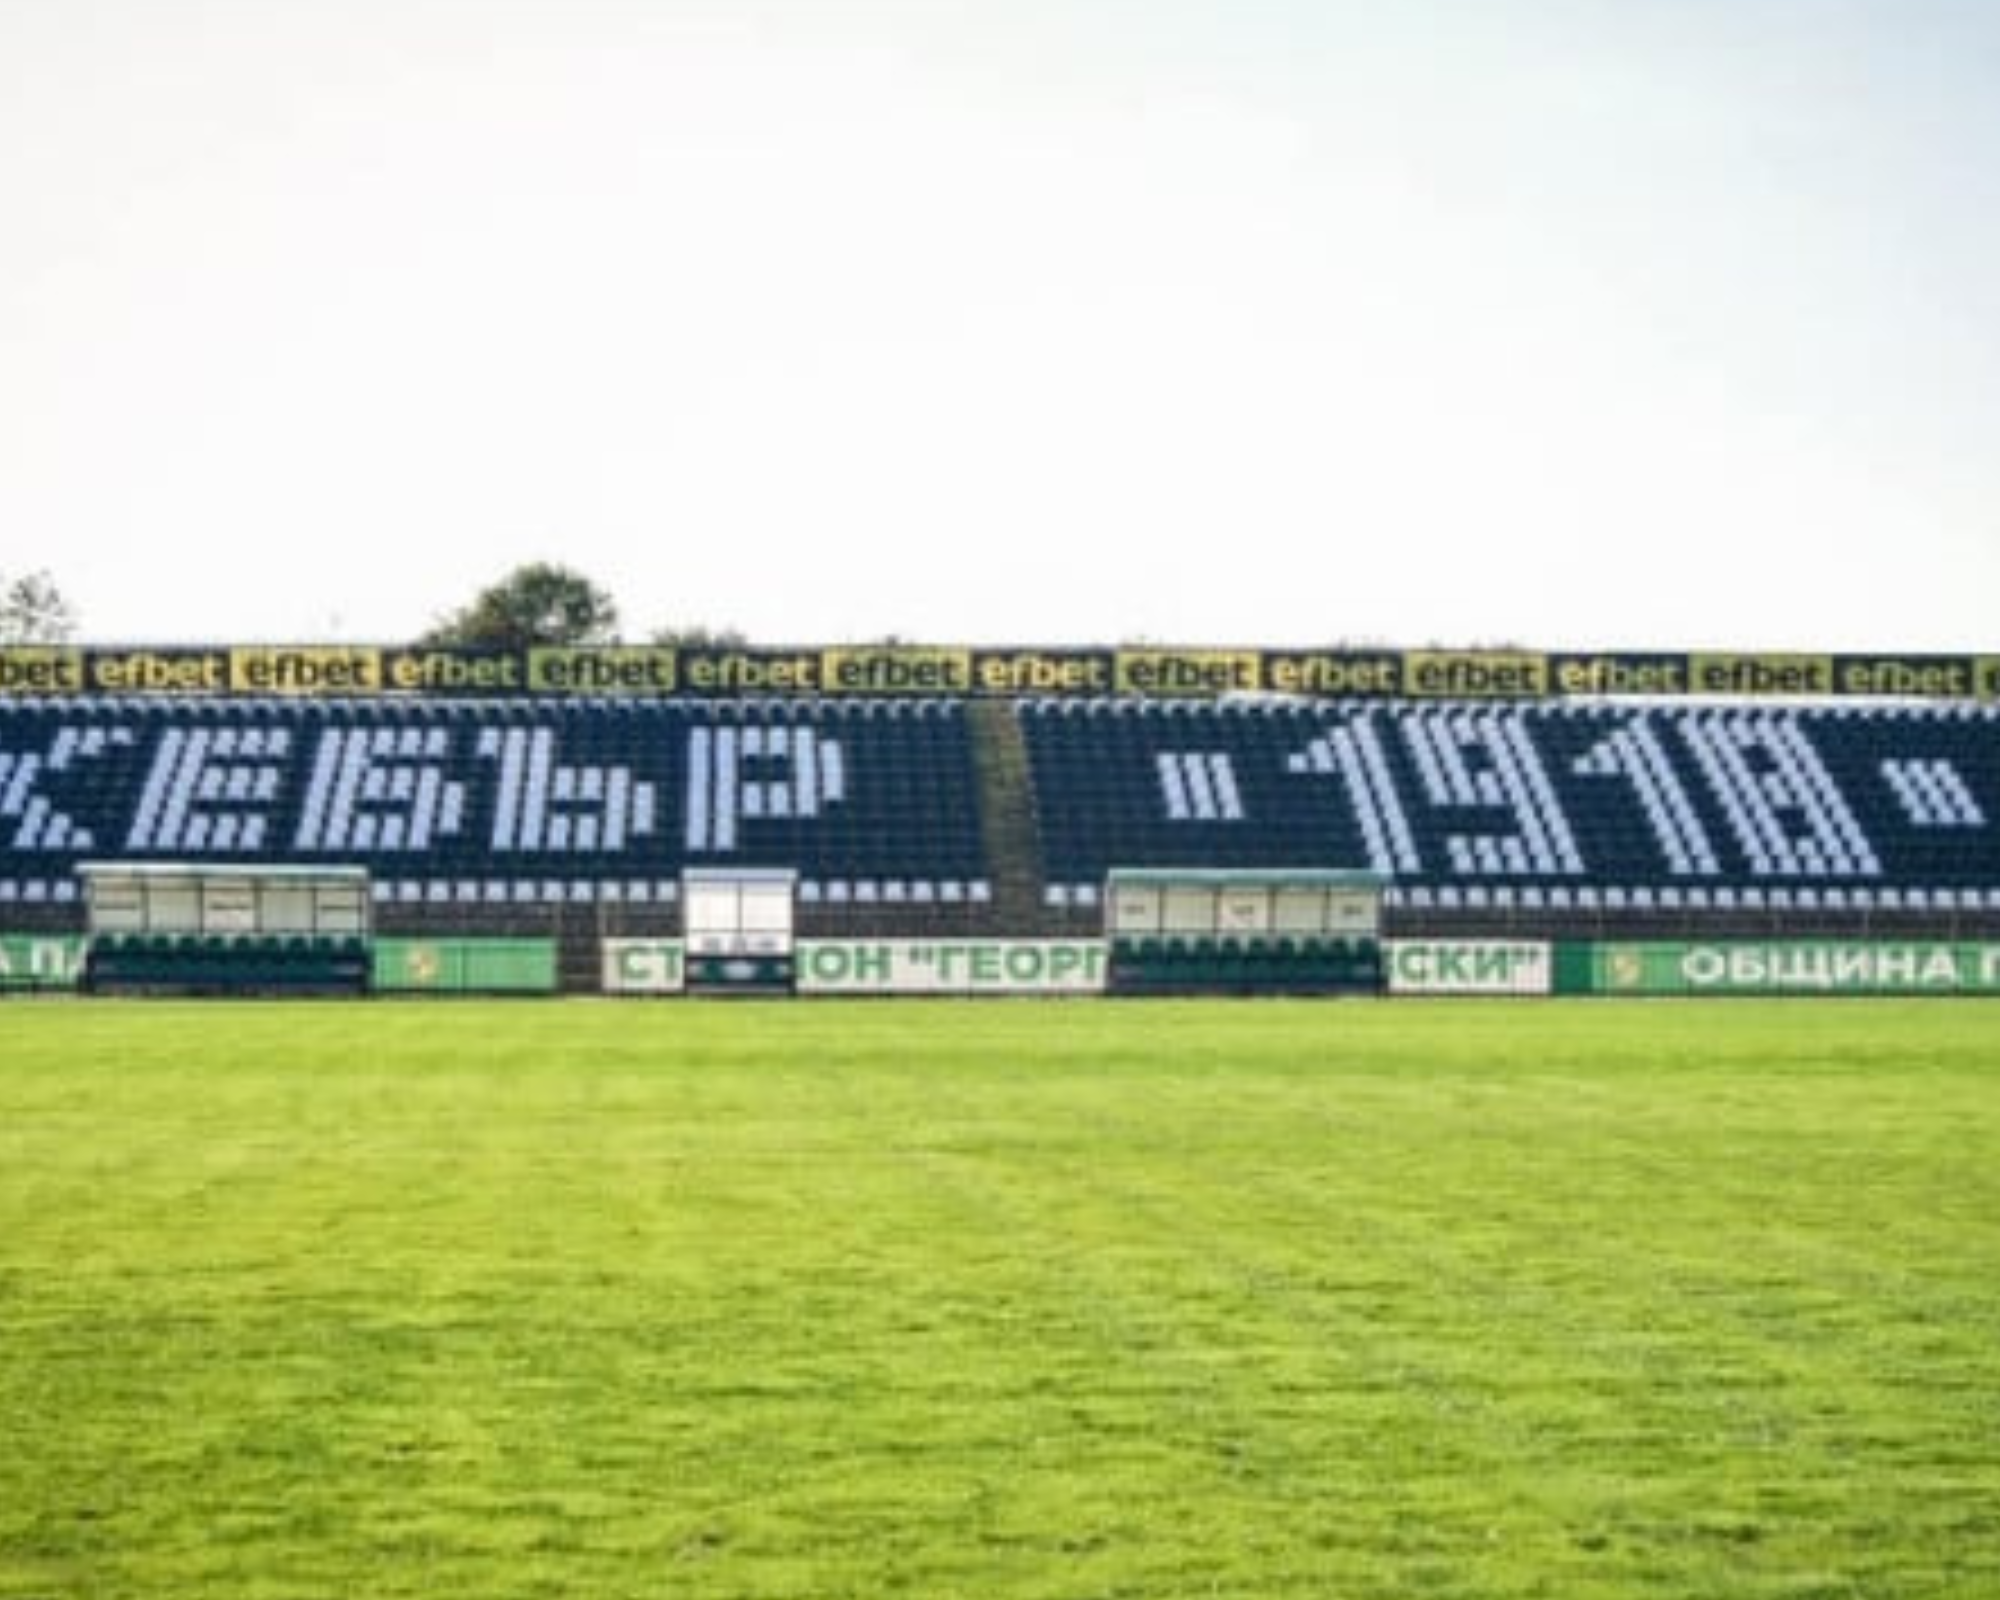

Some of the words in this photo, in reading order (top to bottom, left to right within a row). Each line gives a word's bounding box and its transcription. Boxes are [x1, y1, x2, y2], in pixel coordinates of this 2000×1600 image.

[0, 656, 73, 687] bet
[94, 656, 222, 687] efbet
[244, 655, 371, 686] efbet
[391, 656, 518, 687] efbet
[539, 654, 670, 686] efbet
[688, 656, 816, 687] efbet
[836, 656, 963, 687] efbet
[980, 657, 1107, 688] efbet
[1127, 656, 1250, 688] efbet
[1271, 658, 1396, 689] efbet
[1415, 658, 1540, 690] efbet
[1559, 659, 1680, 690] efbet
[1703, 660, 1822, 691] efbet
[1844, 662, 1965, 692] efbet
[908, 945, 1107, 981] "ГЕОРГ
[1384, 945, 1540, 982] СКИ"
[1681, 944, 1957, 988] ОБЩИНА
